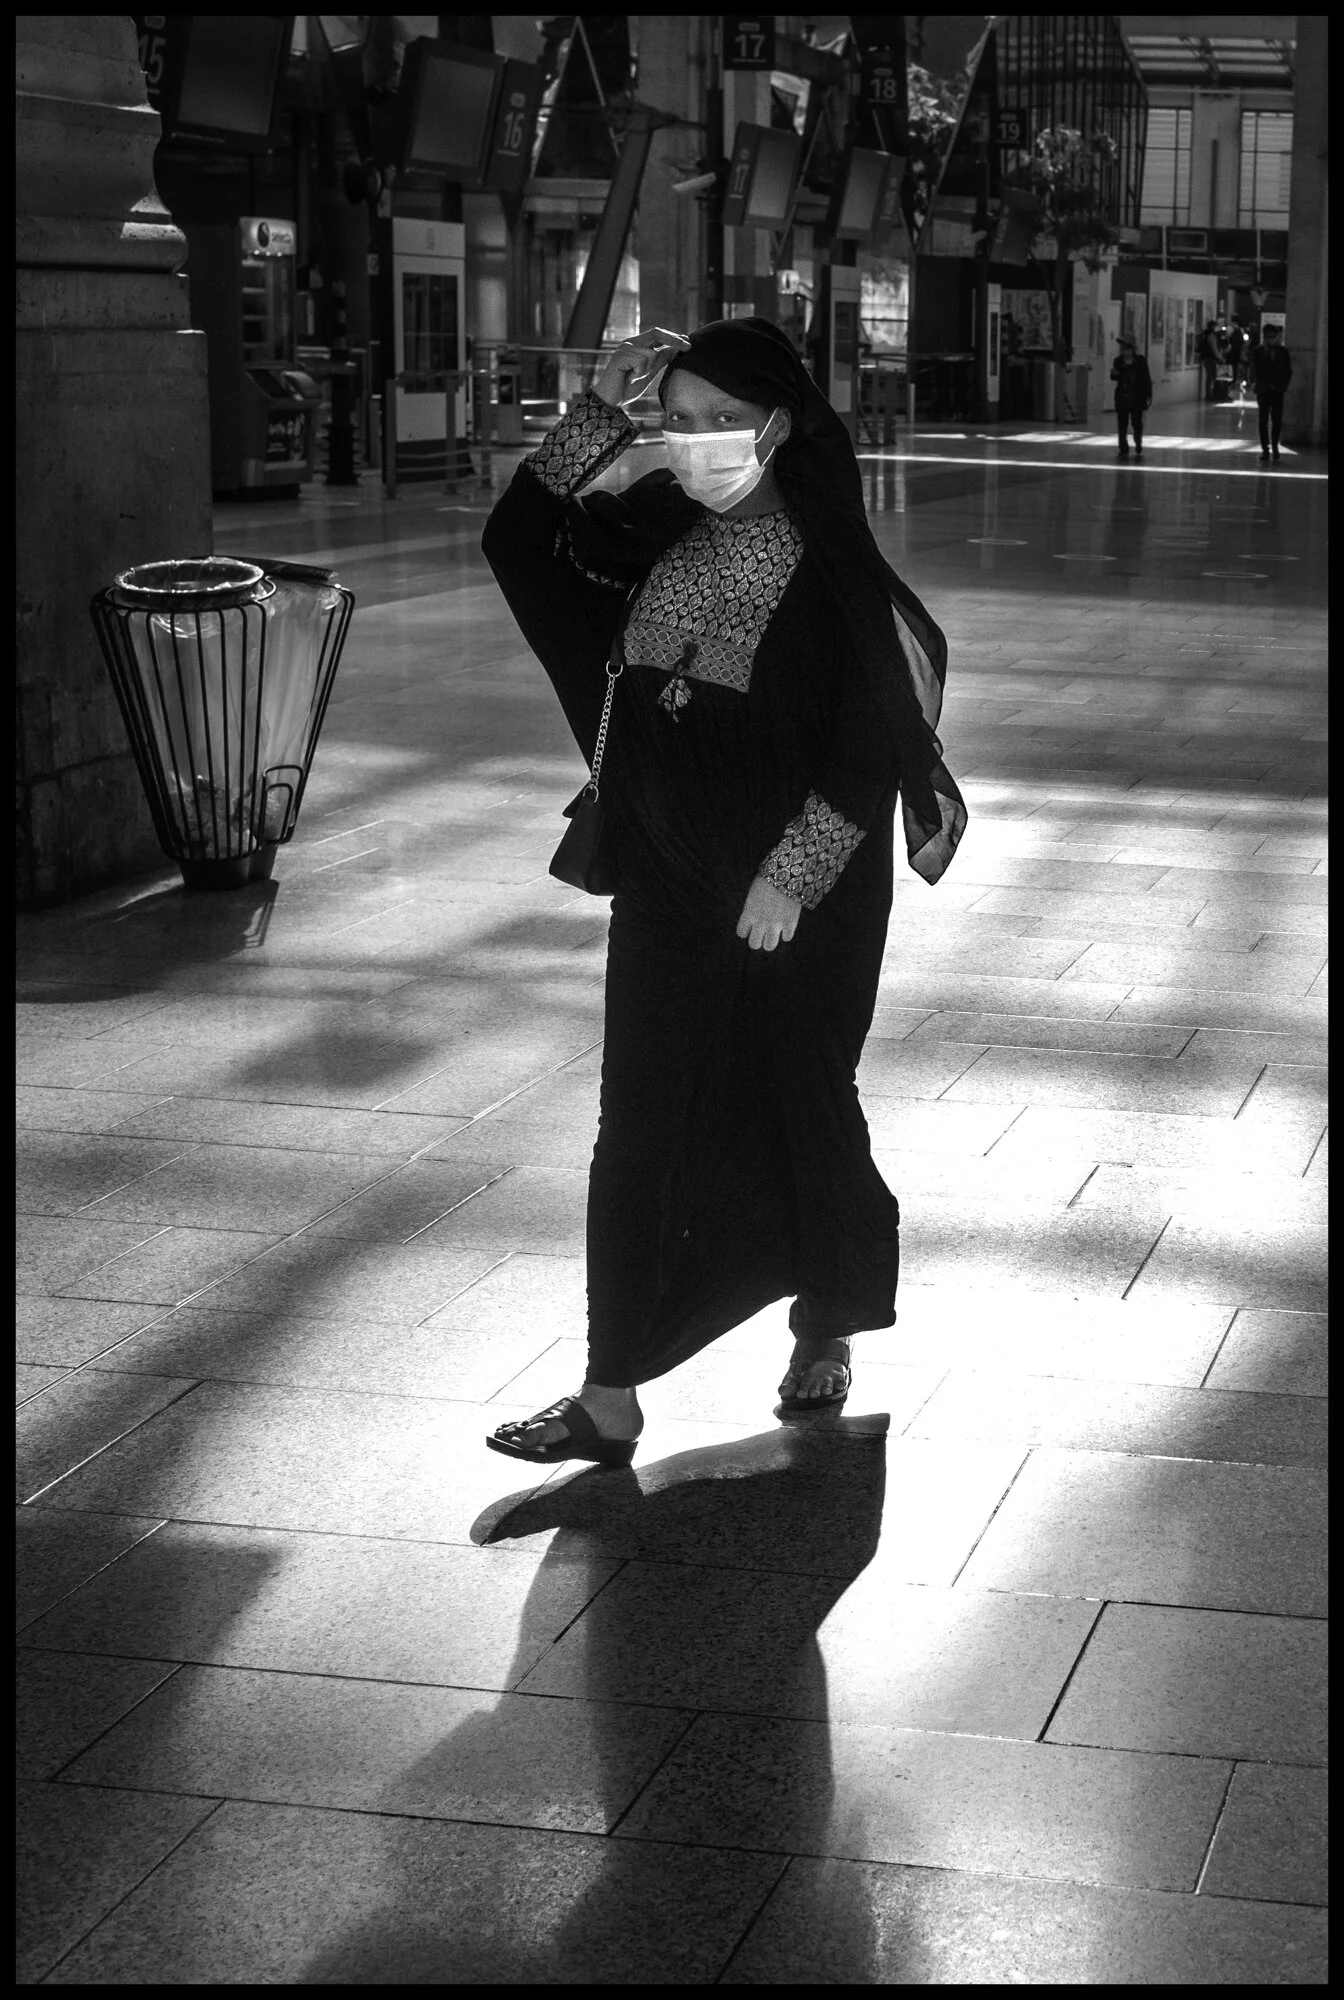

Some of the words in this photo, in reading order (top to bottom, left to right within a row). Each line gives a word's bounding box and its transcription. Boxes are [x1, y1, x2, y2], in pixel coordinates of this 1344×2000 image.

[733, 33, 767, 58] 17
[869, 77, 898, 99] 18
[504, 111, 525, 150] 16
[996, 122, 1020, 140] 19
